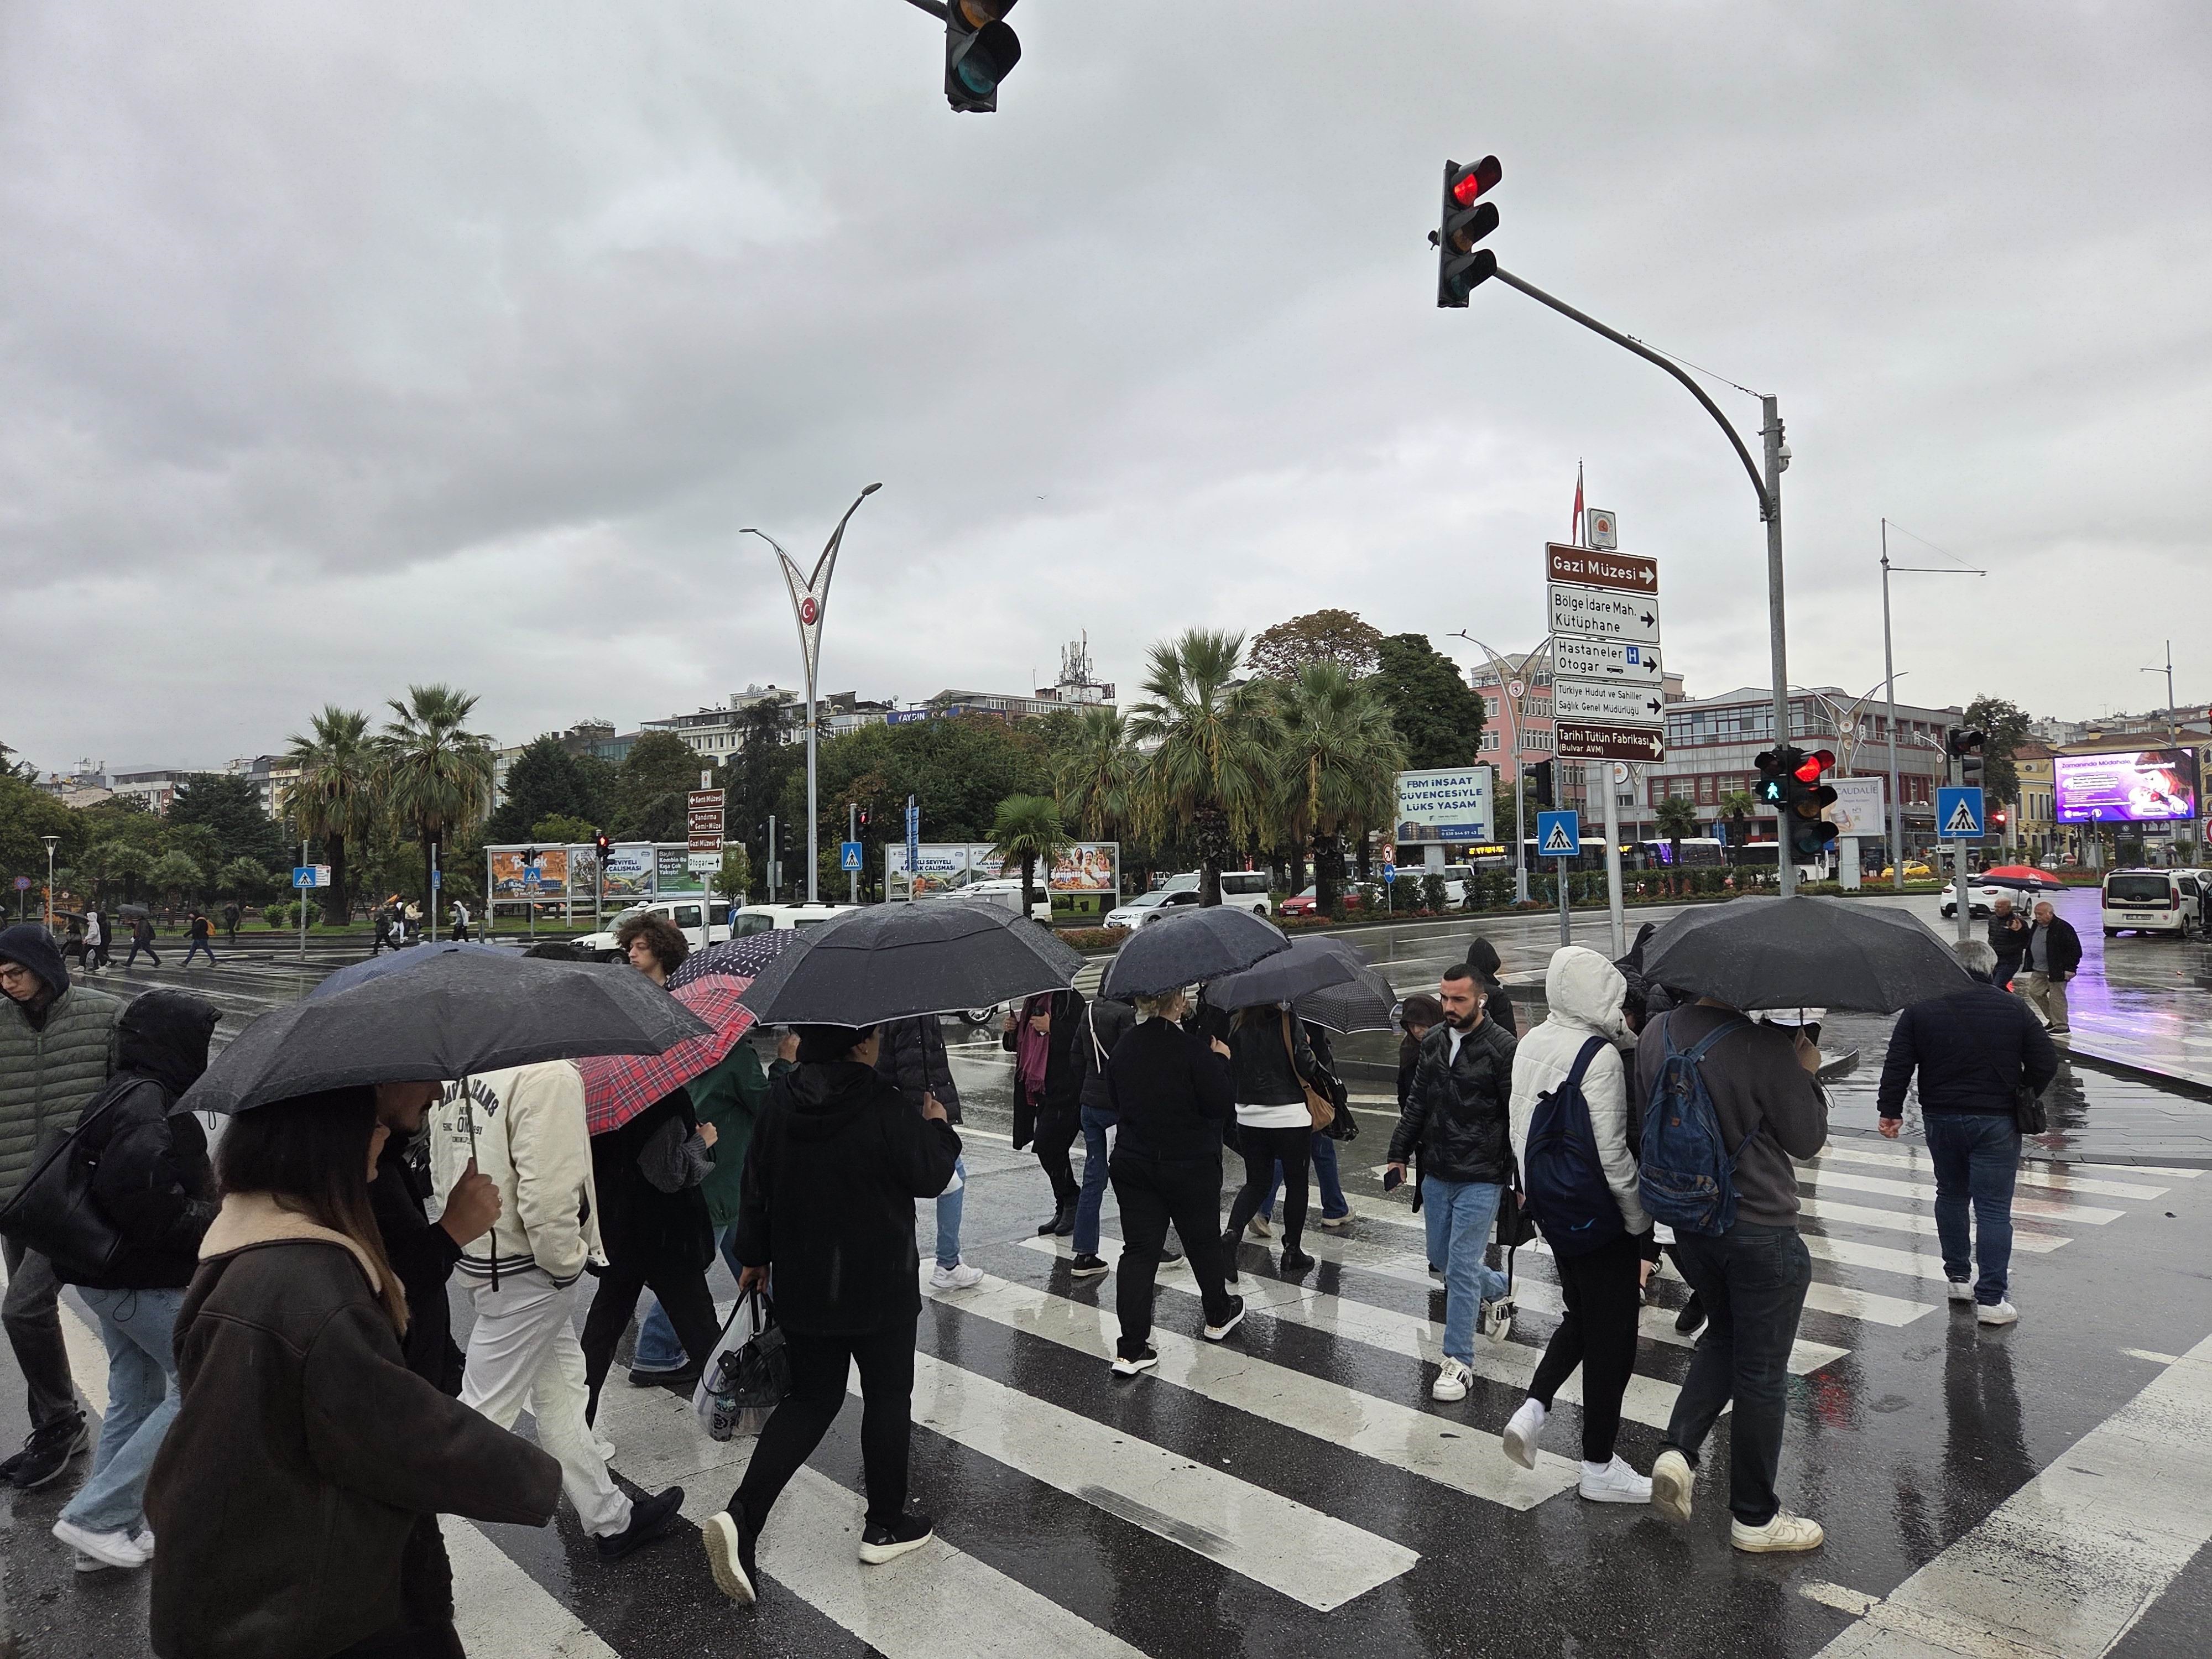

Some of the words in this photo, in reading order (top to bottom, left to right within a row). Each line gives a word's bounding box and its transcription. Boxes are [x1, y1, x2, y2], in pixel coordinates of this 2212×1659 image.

[1553, 556, 1584, 573] Gazi
[1588, 560, 1636, 580] Müzesi
[1555, 593, 1584, 611] Bölge
[1585, 594, 1610, 612] İdare
[1613, 601, 1636, 616] Mah.
[1556, 613, 1620, 632] Kütüphane
[1559, 641, 1623, 659] Hastaneler
[1628, 648, 1637, 662] H
[1559, 657, 1599, 673] Otogar
[1558, 685, 1583, 697] Türkiye
[1585, 687, 1606, 697] Hudut
[1618, 691, 1642, 700] Sahiller
[1559, 701, 1579, 711] Sağlık
[1582, 702, 1600, 711] Genel
[1604, 704, 1639, 716] Müdürlüğü
[1558, 729, 1583, 741] Tarihi
[1585, 731, 1610, 743] Tütün
[1613, 733, 1649, 745] Fabrikası
[1559, 744, 1584, 753] (Bulvar
[1586, 745, 1604, 755] AVM)
[1407, 780, 1428, 789] FBM
[1432, 777, 1473, 786] İNŞAAT
[1400, 789, 1483, 800] GÜVENCESİYLE
[1406, 802, 1434, 811] LÜKS
[1437, 801, 1476, 810] YAŞAM
[689, 858, 707, 868] Otogar
